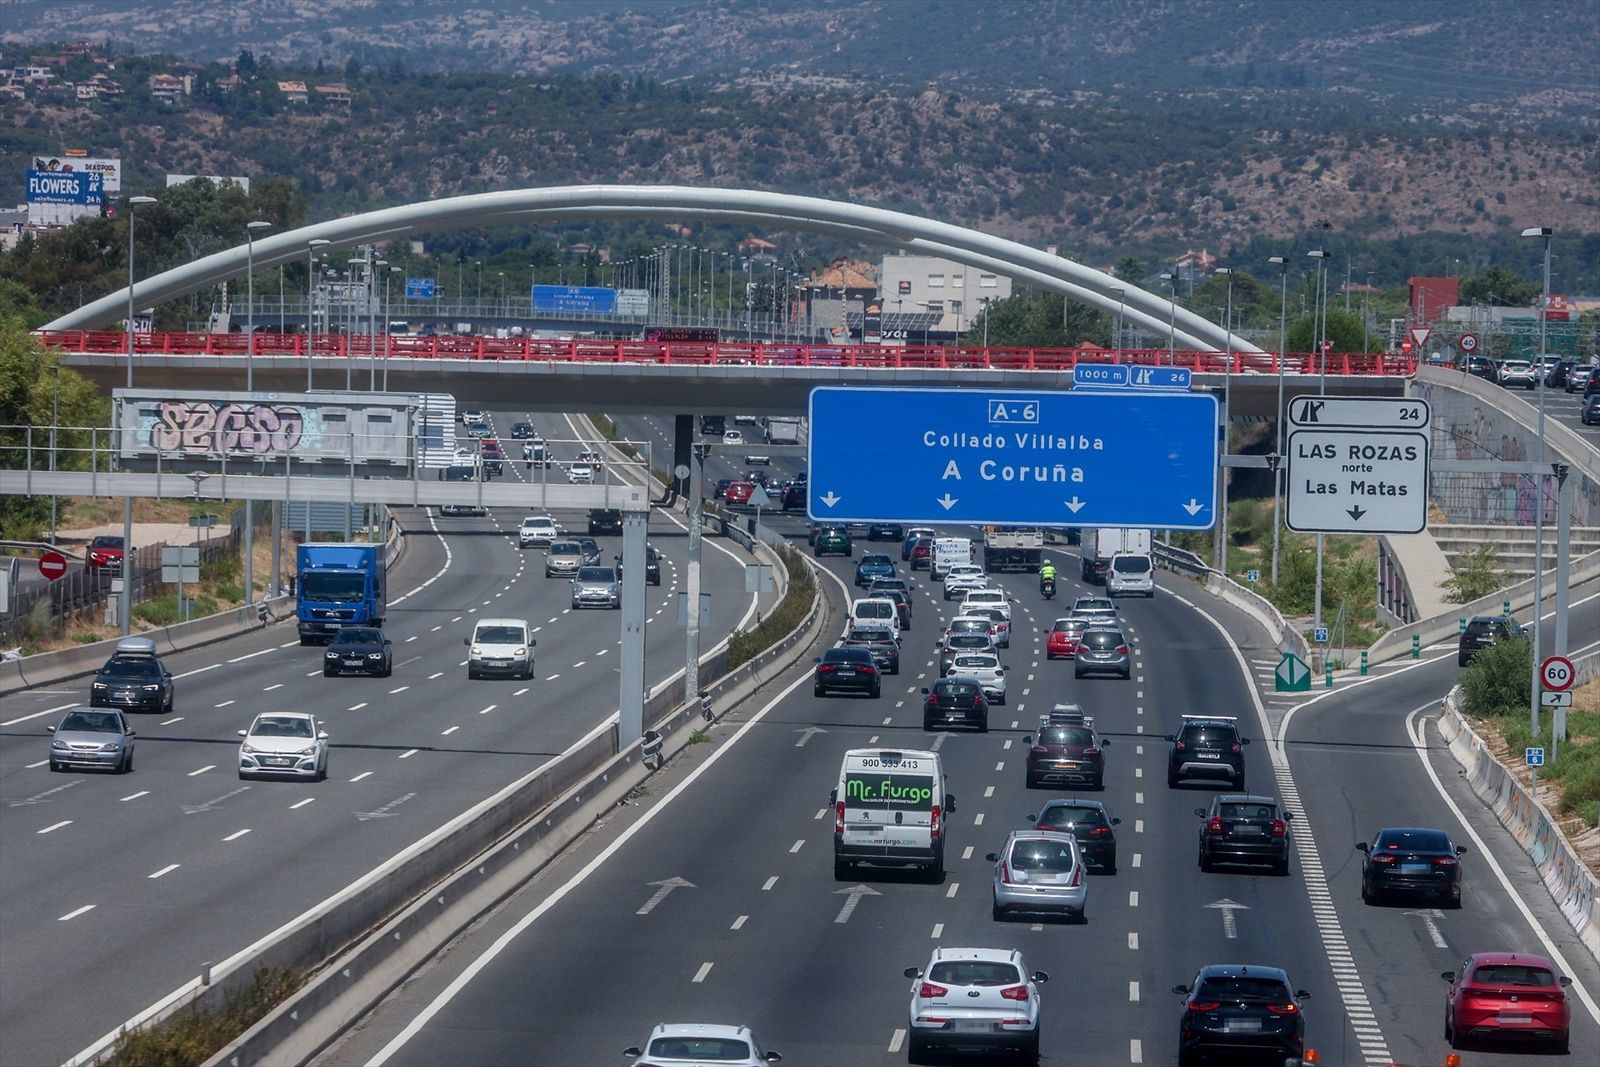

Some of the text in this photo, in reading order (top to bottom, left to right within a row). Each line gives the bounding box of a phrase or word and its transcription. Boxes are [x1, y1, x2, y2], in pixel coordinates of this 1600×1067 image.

[88, 173, 99, 181] 26
[30, 178, 80, 195] FLOWERS
[1463, 339, 1473, 347] 40
[1080, 370, 1108, 379] 1000
[1171, 373, 1185, 382] 26
[993, 403, 1036, 420] A-6
[1399, 408, 1420, 421] 24
[923, 431, 1104, 450] Collado Villalba
[1299, 444, 1417, 461] LAS ROZAS
[942, 459, 1084, 483] A Coruña
[1342, 463, 1373, 473] norte
[1306, 480, 1408, 496] Las Matas
[1548, 668, 1567, 680] 60
[863, 759, 880, 768] 900
[901, 761, 918, 769] 413
[847, 780, 931, 804] Mr. Furgo
